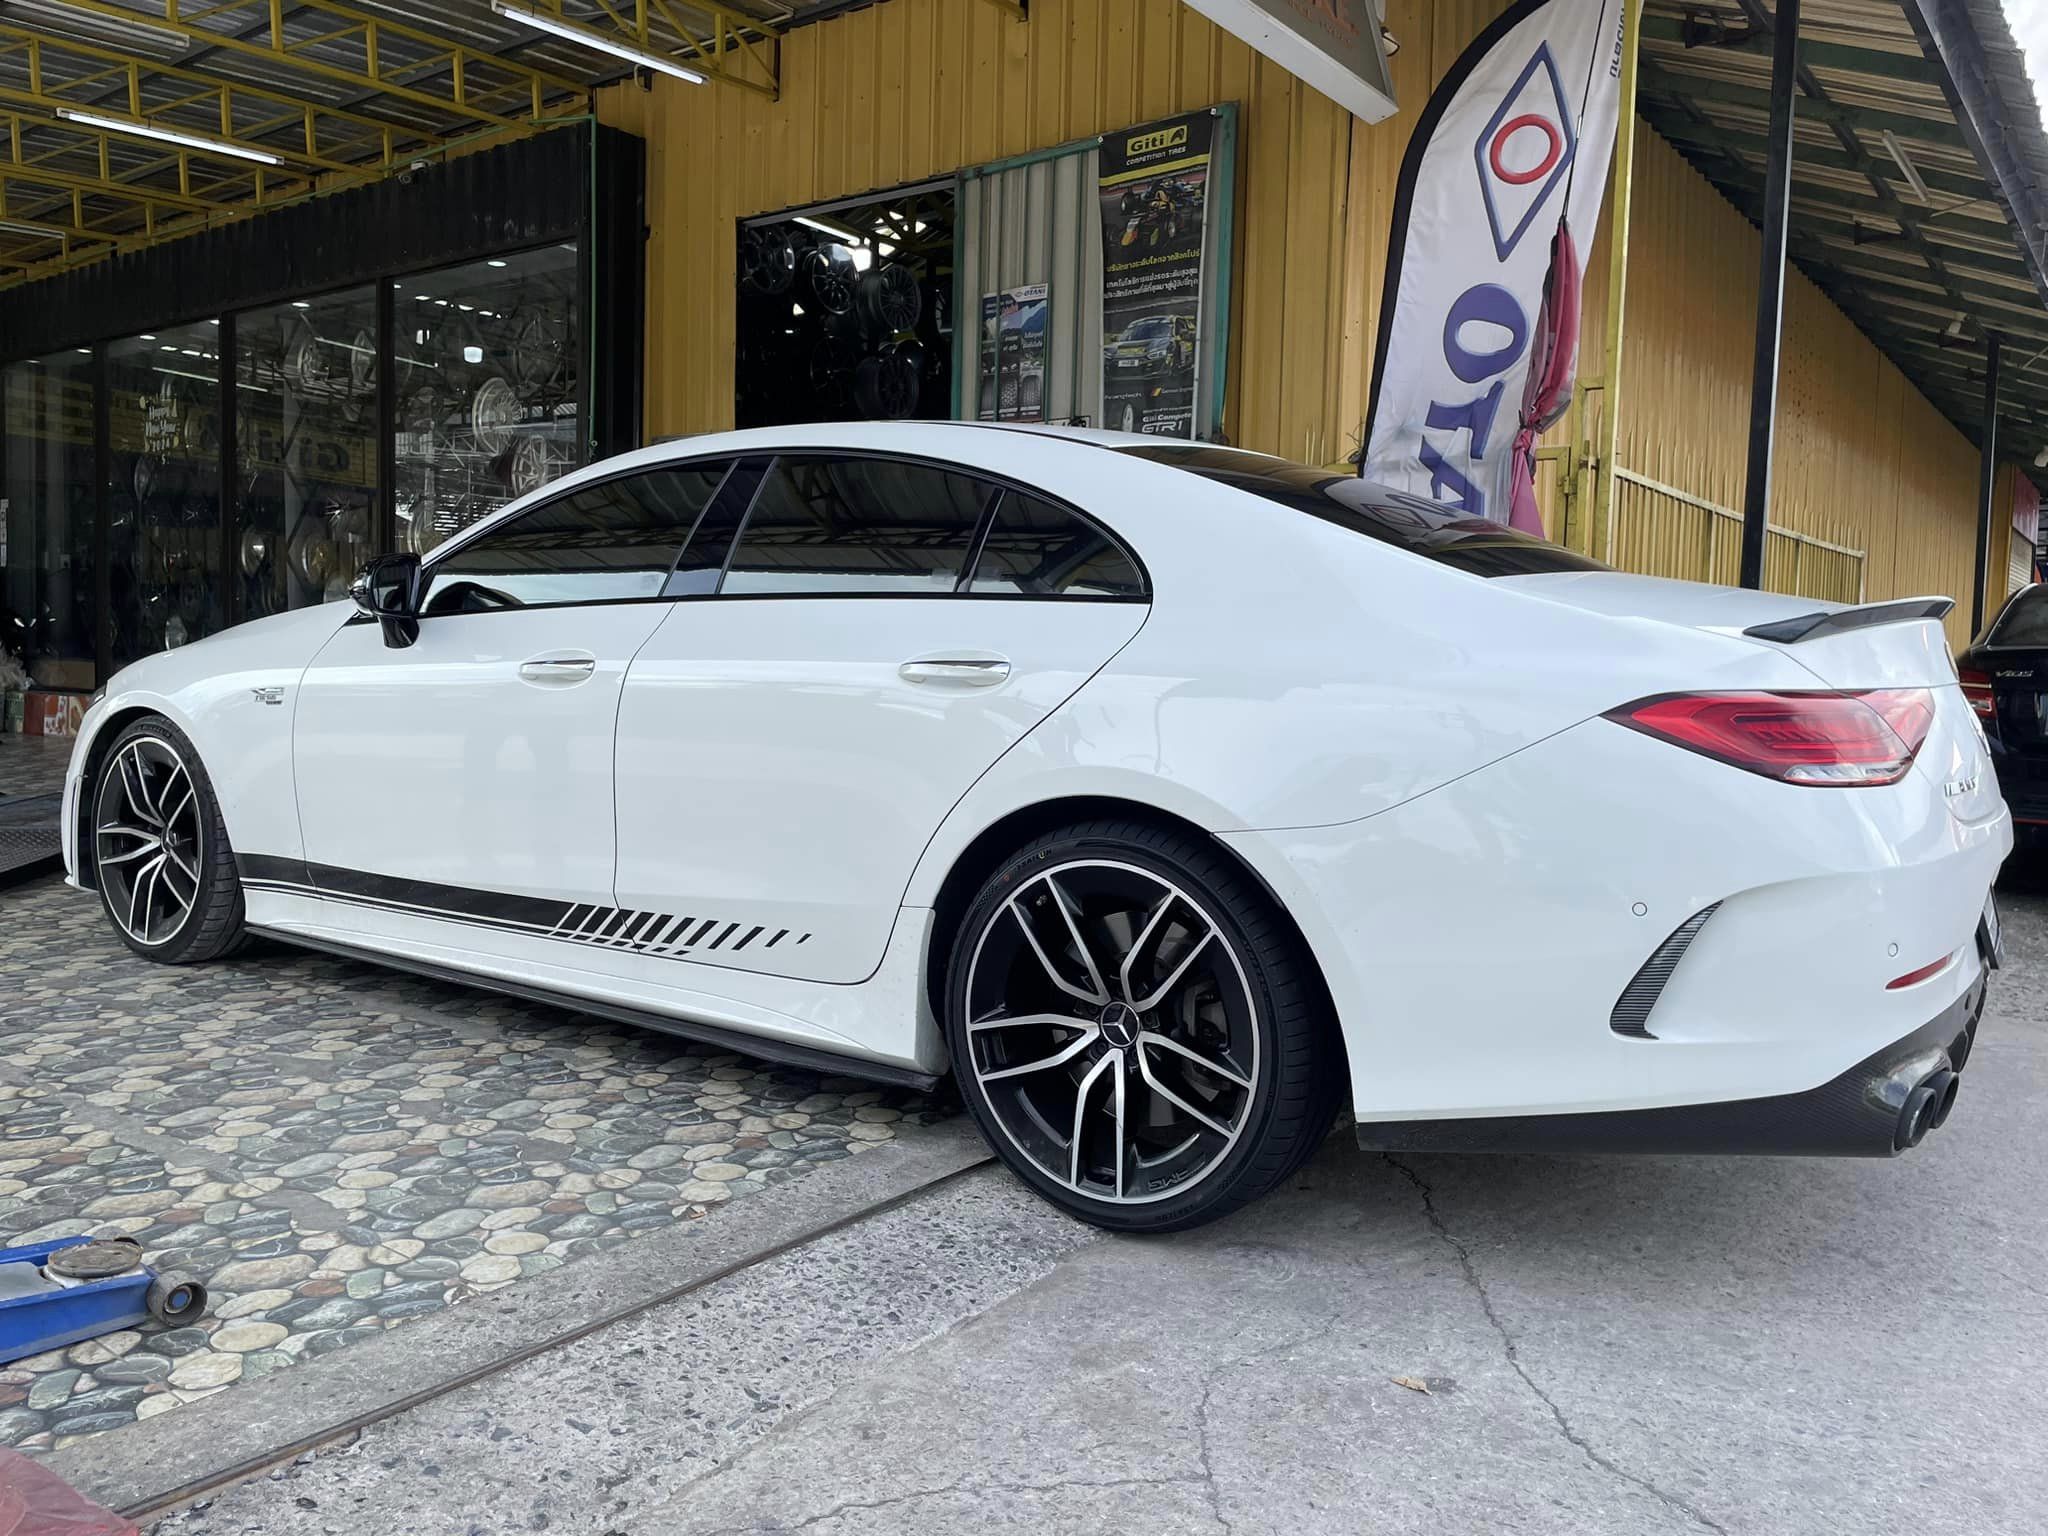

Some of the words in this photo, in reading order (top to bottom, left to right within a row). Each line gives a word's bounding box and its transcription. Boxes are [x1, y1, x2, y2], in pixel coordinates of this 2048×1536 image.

[1131, 135, 1164, 152] Giti
[1024, 288, 1046, 297] OTANI
[1142, 420, 1182, 434] GTR1
